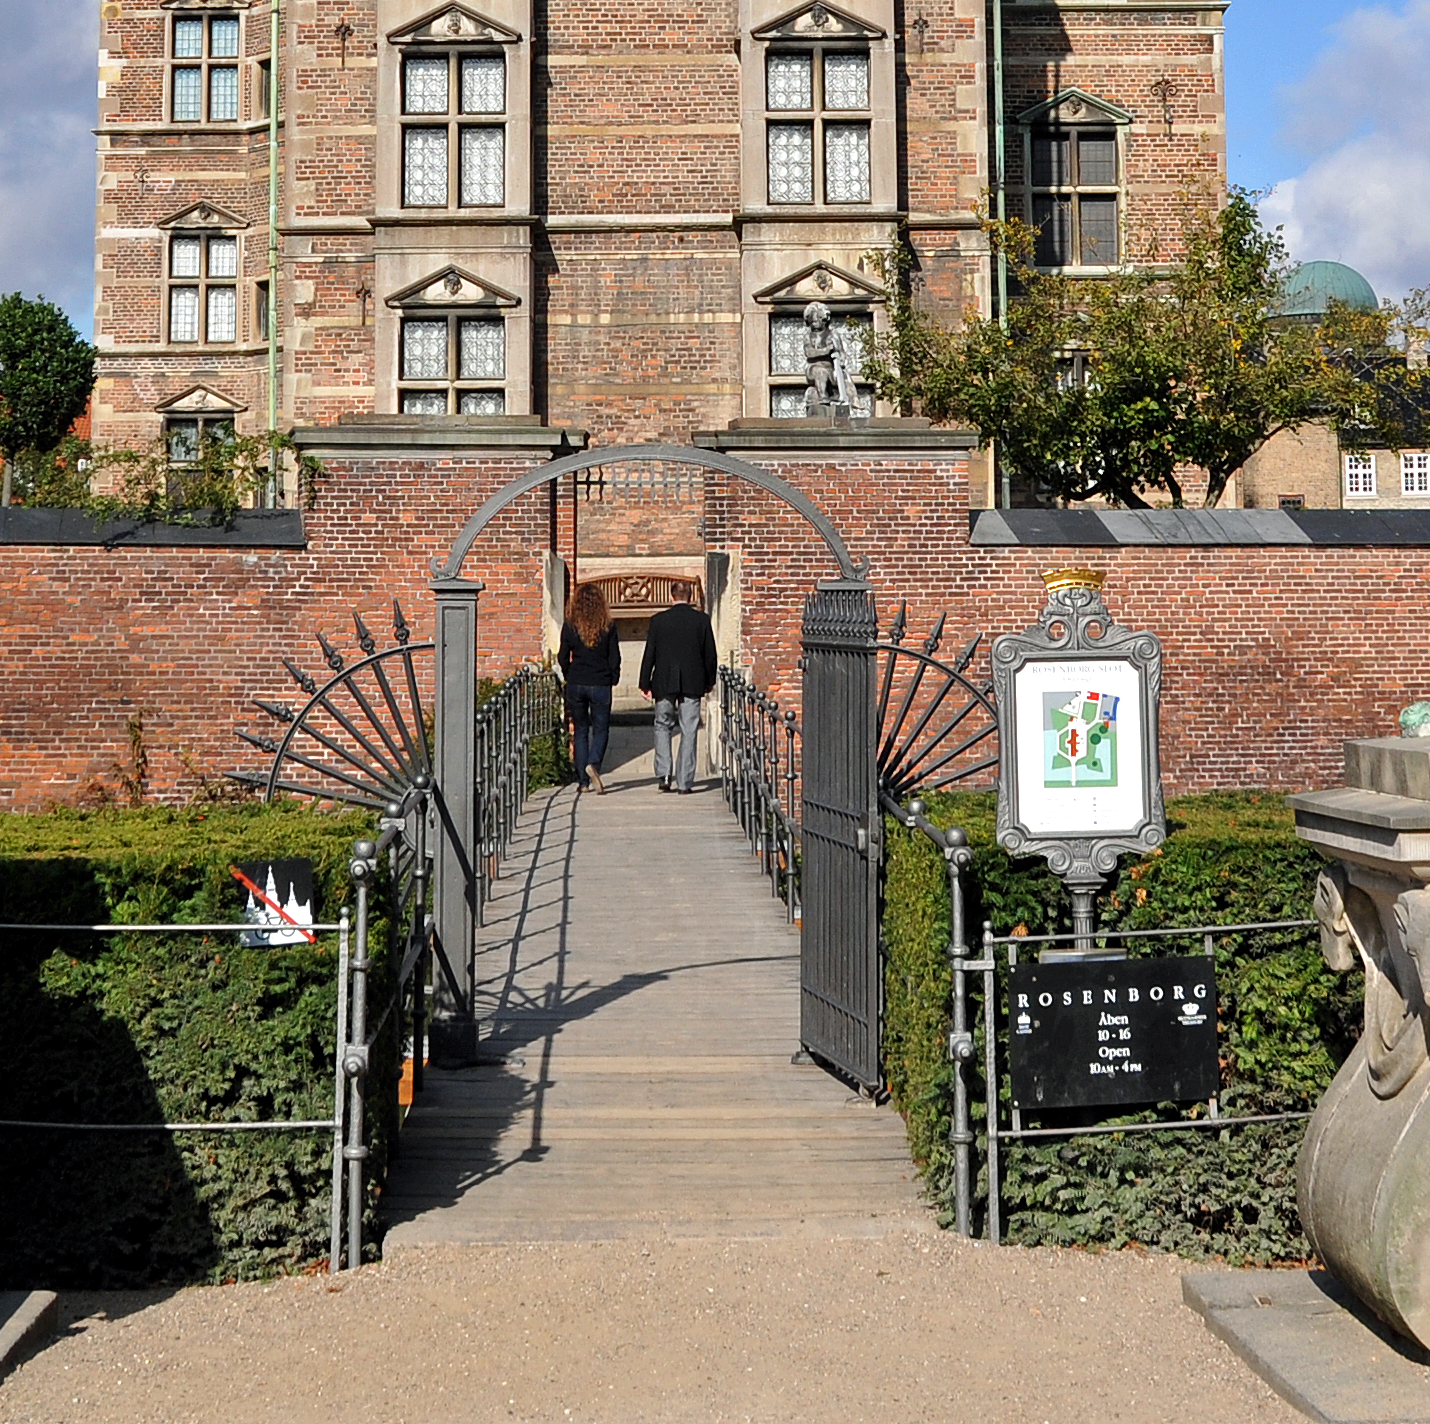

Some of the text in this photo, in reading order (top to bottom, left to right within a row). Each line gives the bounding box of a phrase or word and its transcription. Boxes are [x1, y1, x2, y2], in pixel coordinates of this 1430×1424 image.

[1017, 984, 1207, 1008] ROSENBORG
[1098, 1011, 1129, 1026] Åben
[1097, 1029, 1110, 1041] 10
[1118, 1027, 1132, 1041] 16
[1098, 1046, 1131, 1060] Open
